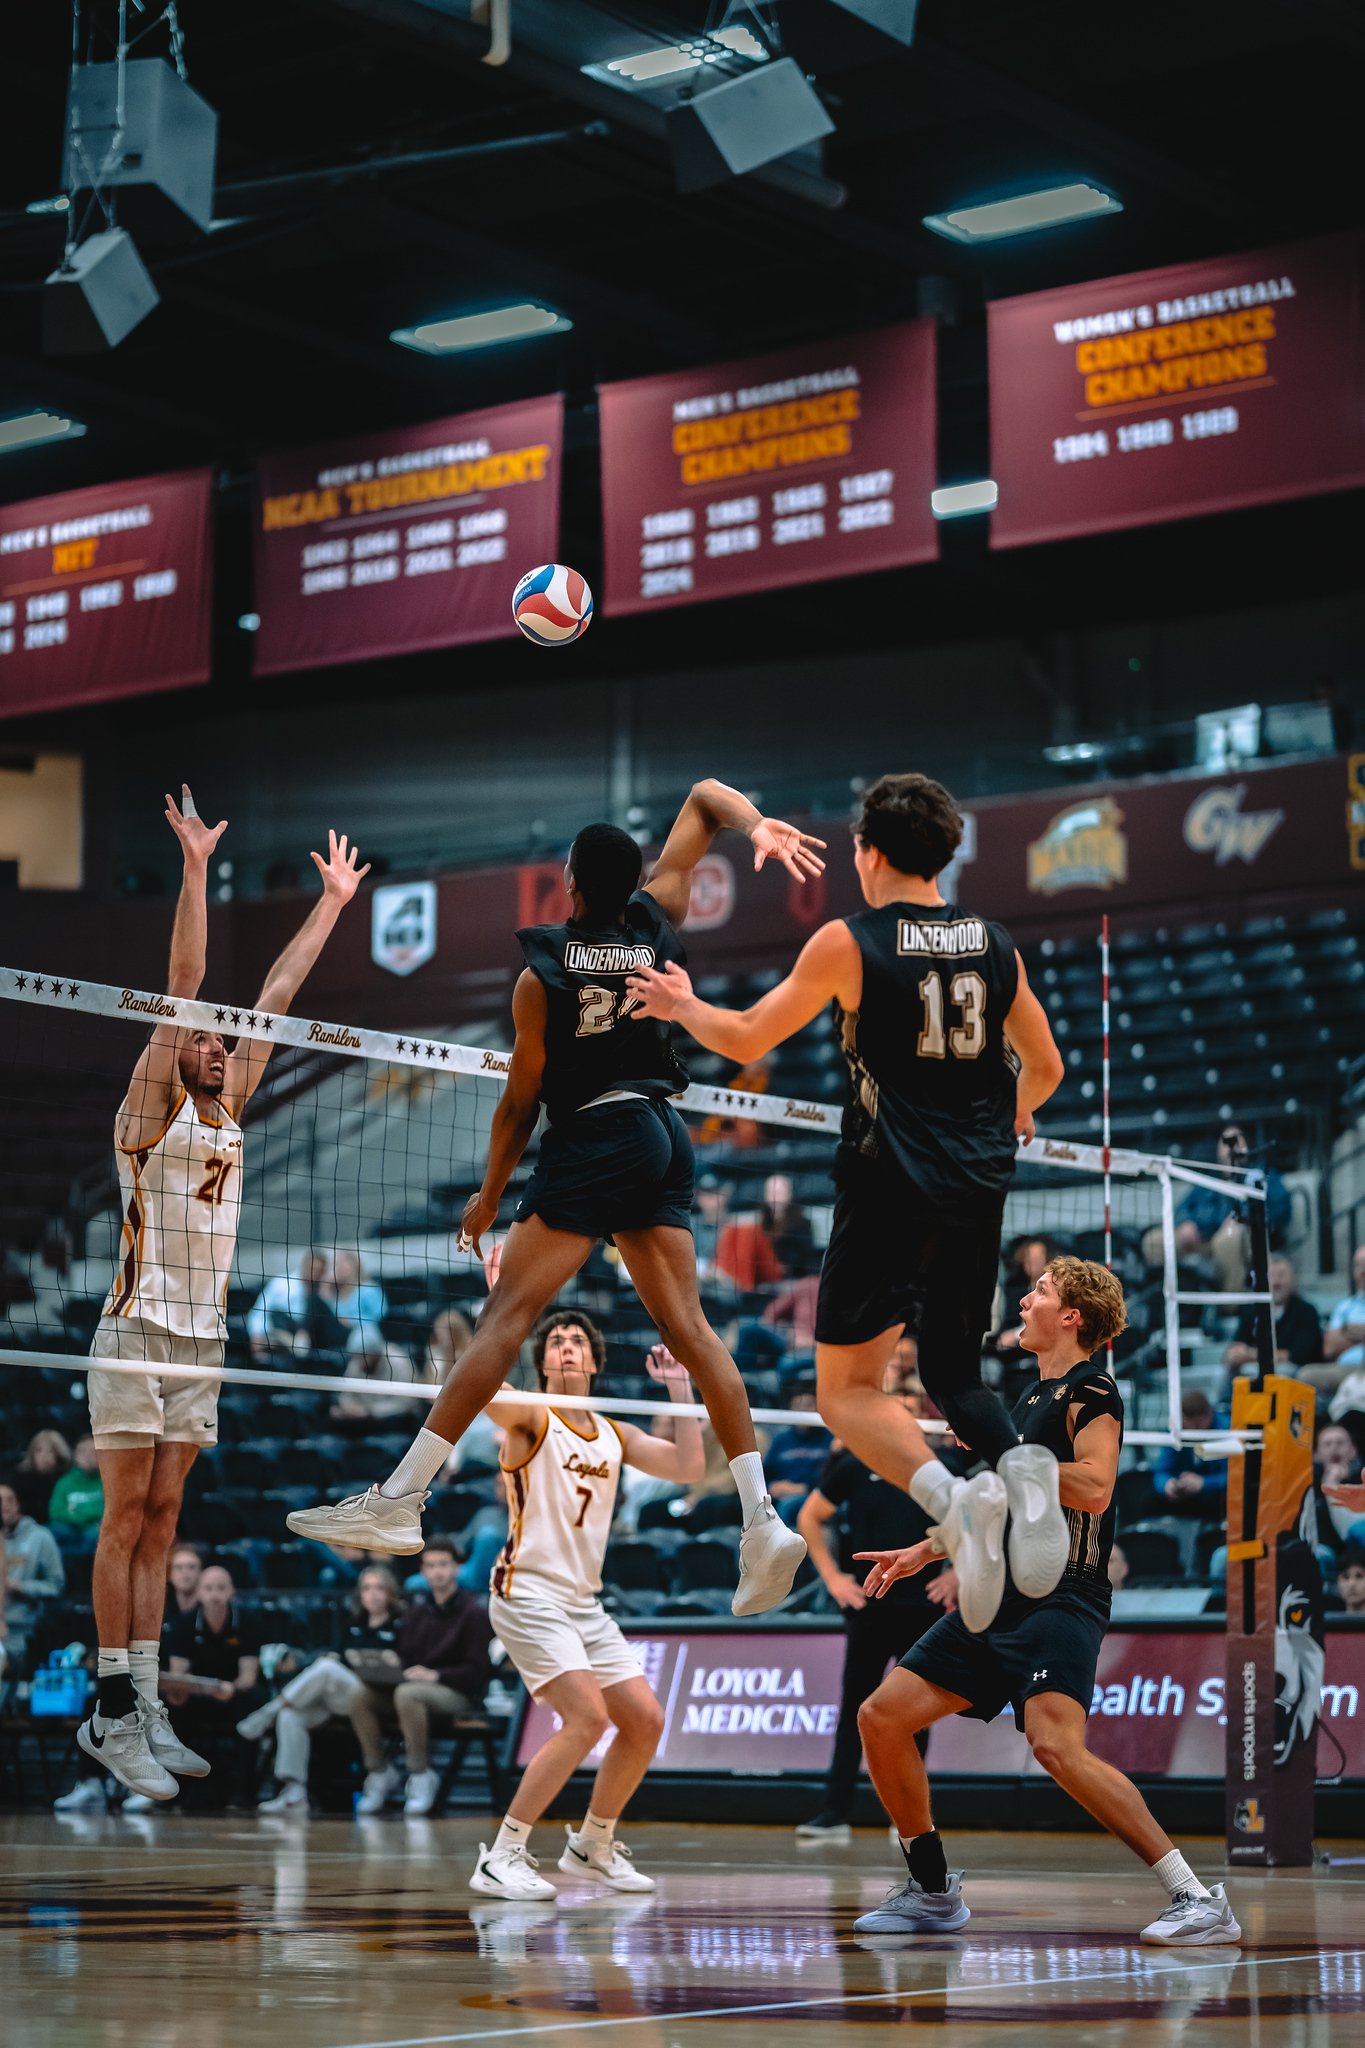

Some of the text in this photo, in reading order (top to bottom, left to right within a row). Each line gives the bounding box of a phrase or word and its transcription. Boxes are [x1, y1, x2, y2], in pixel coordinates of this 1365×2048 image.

[1054, 276, 1296, 344] WOMEN'S BASKETBALL
[1076, 305, 1276, 374] CONFERENCE
[673, 366, 860, 422] MEN'S BASKETBALL
[1085, 342, 1267, 406] CHAMPIONS
[673, 389, 860, 455] CONFERENCE
[317, 438, 490, 489] MEN'S BASKETBALL
[681, 423, 850, 484] CHAMPIONS
[263, 444, 550, 530] NCAA TOURNAMENT
[51, 504, 153, 544] BASKETBALL
[568, 945, 652, 971] LINDENWOOD
[903, 922, 983, 954] LINDENWOOD
[118, 989, 177, 1018] Ramblers
[576, 985, 639, 1037] 2
[917, 971, 986, 1059] 13
[307, 1022, 361, 1048] Ramblers
[481, 1051, 512, 1072] Ramb
[196, 1158, 232, 1205] 21
[562, 1453, 609, 1479] Loyola
[575, 1486, 592, 1527] 7
[690, 1667, 805, 1697] LOYOLA
[1089, 1675, 1186, 1717] ealth
[681, 1704, 839, 1734] MEDICINE
[1242, 1661, 1257, 1781] sports imports
